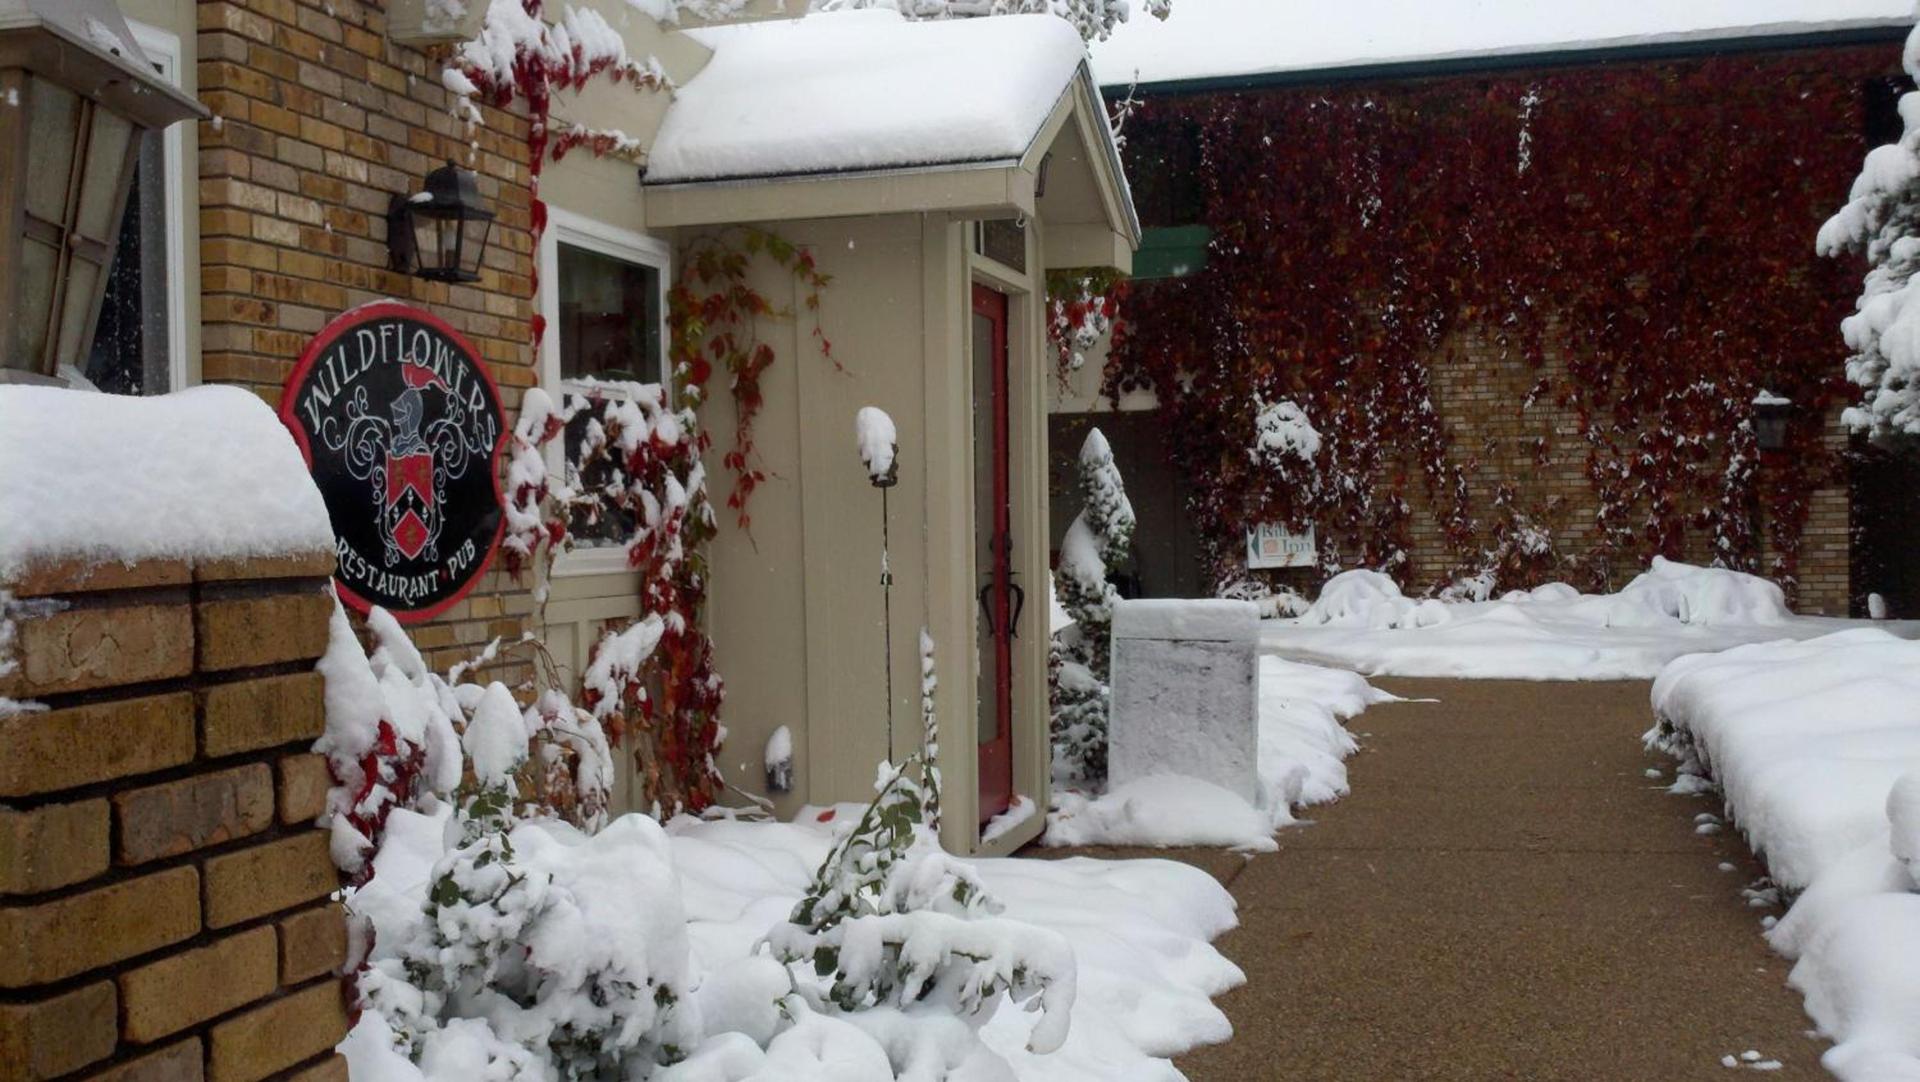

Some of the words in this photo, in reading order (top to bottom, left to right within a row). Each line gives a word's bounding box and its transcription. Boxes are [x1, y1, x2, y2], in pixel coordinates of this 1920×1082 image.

[305, 323, 496, 459] WILDFLOWERS
[335, 536, 440, 606] RESTAURANT
[447, 538, 477, 580] PUB
